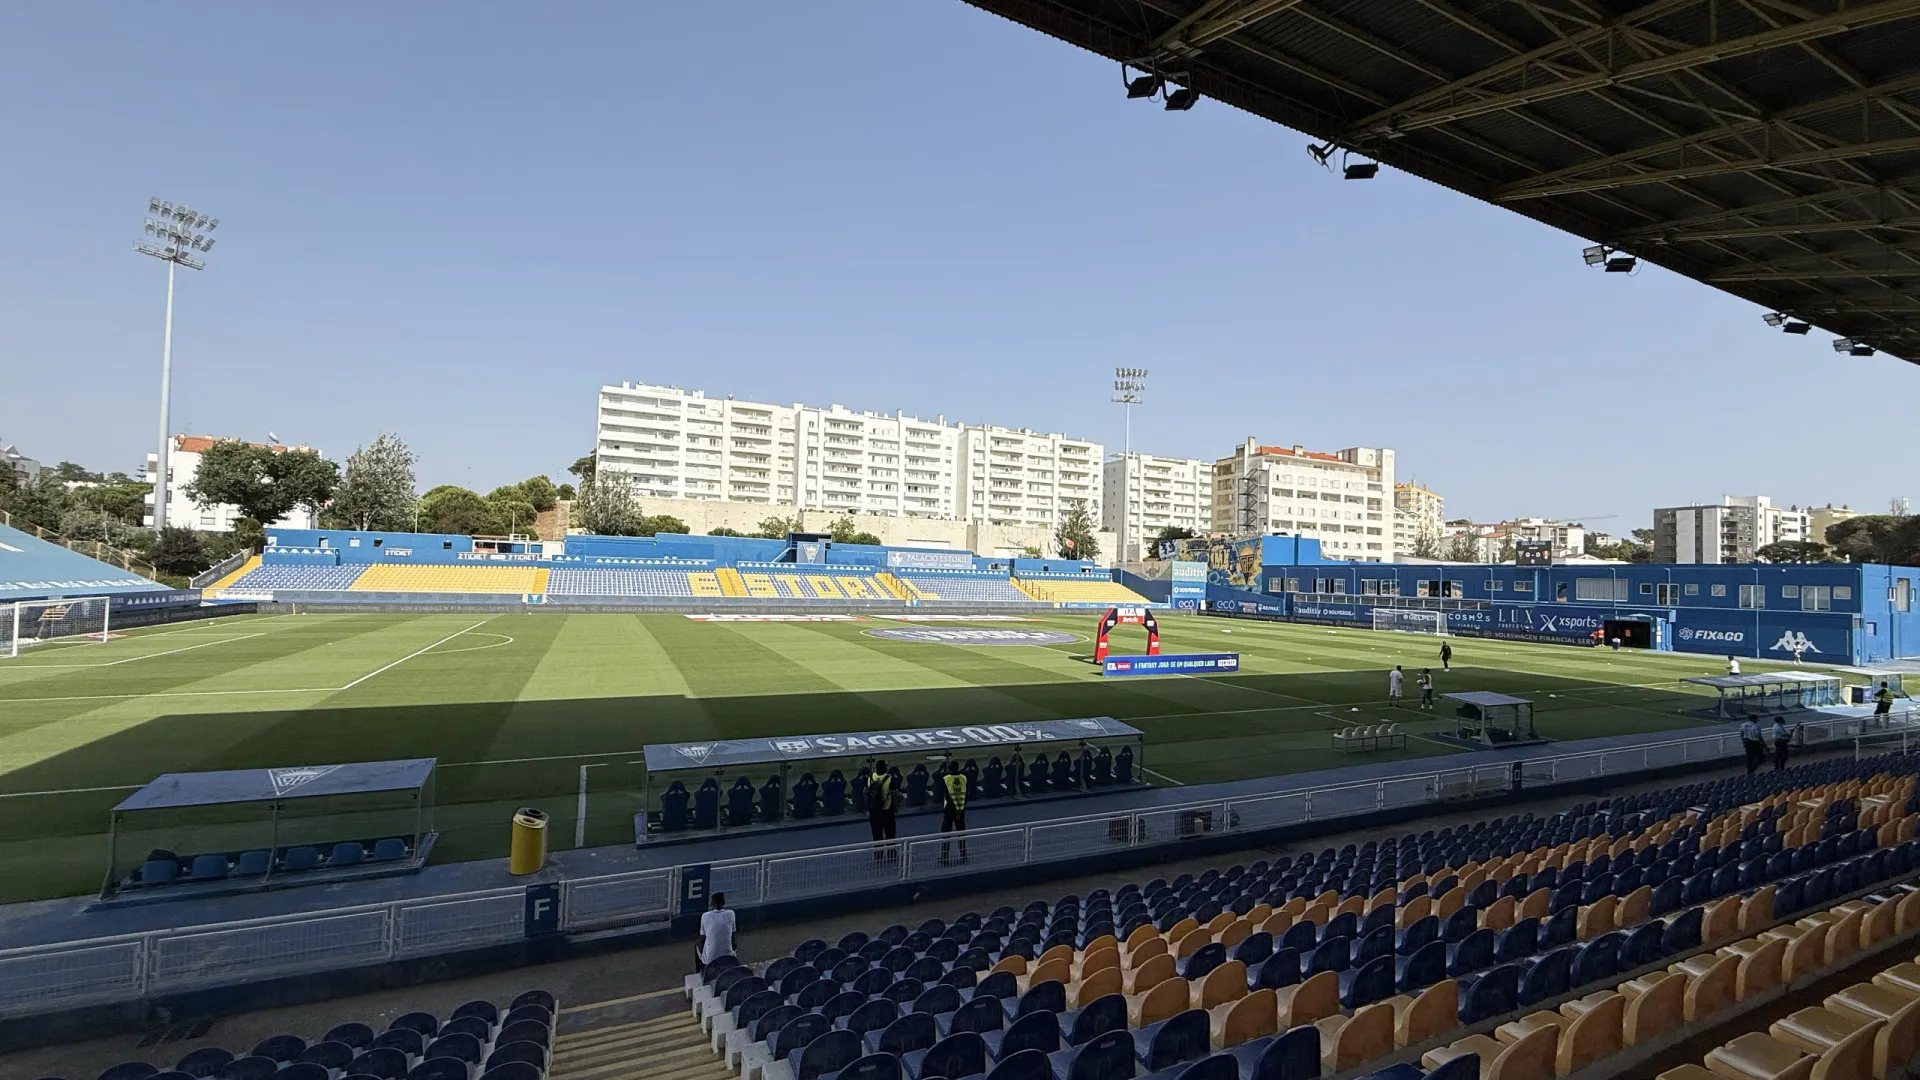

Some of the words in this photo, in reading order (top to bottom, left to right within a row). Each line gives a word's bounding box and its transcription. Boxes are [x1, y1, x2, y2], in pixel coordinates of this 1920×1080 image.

[1174, 567, 1205, 577] auditiv
[1448, 612, 1491, 622] COSMOS
[1498, 608, 1534, 624] LUX
[1558, 615, 1597, 629] xsports
[1494, 632, 1538, 640] VOLKSWAGEN
[1539, 635, 1576, 643] FINANCIAL
[1694, 630, 1744, 642] FIX&GO
[815, 729, 967, 753] SAGRES
[688, 878, 703, 899] E
[534, 899, 551, 920] F
